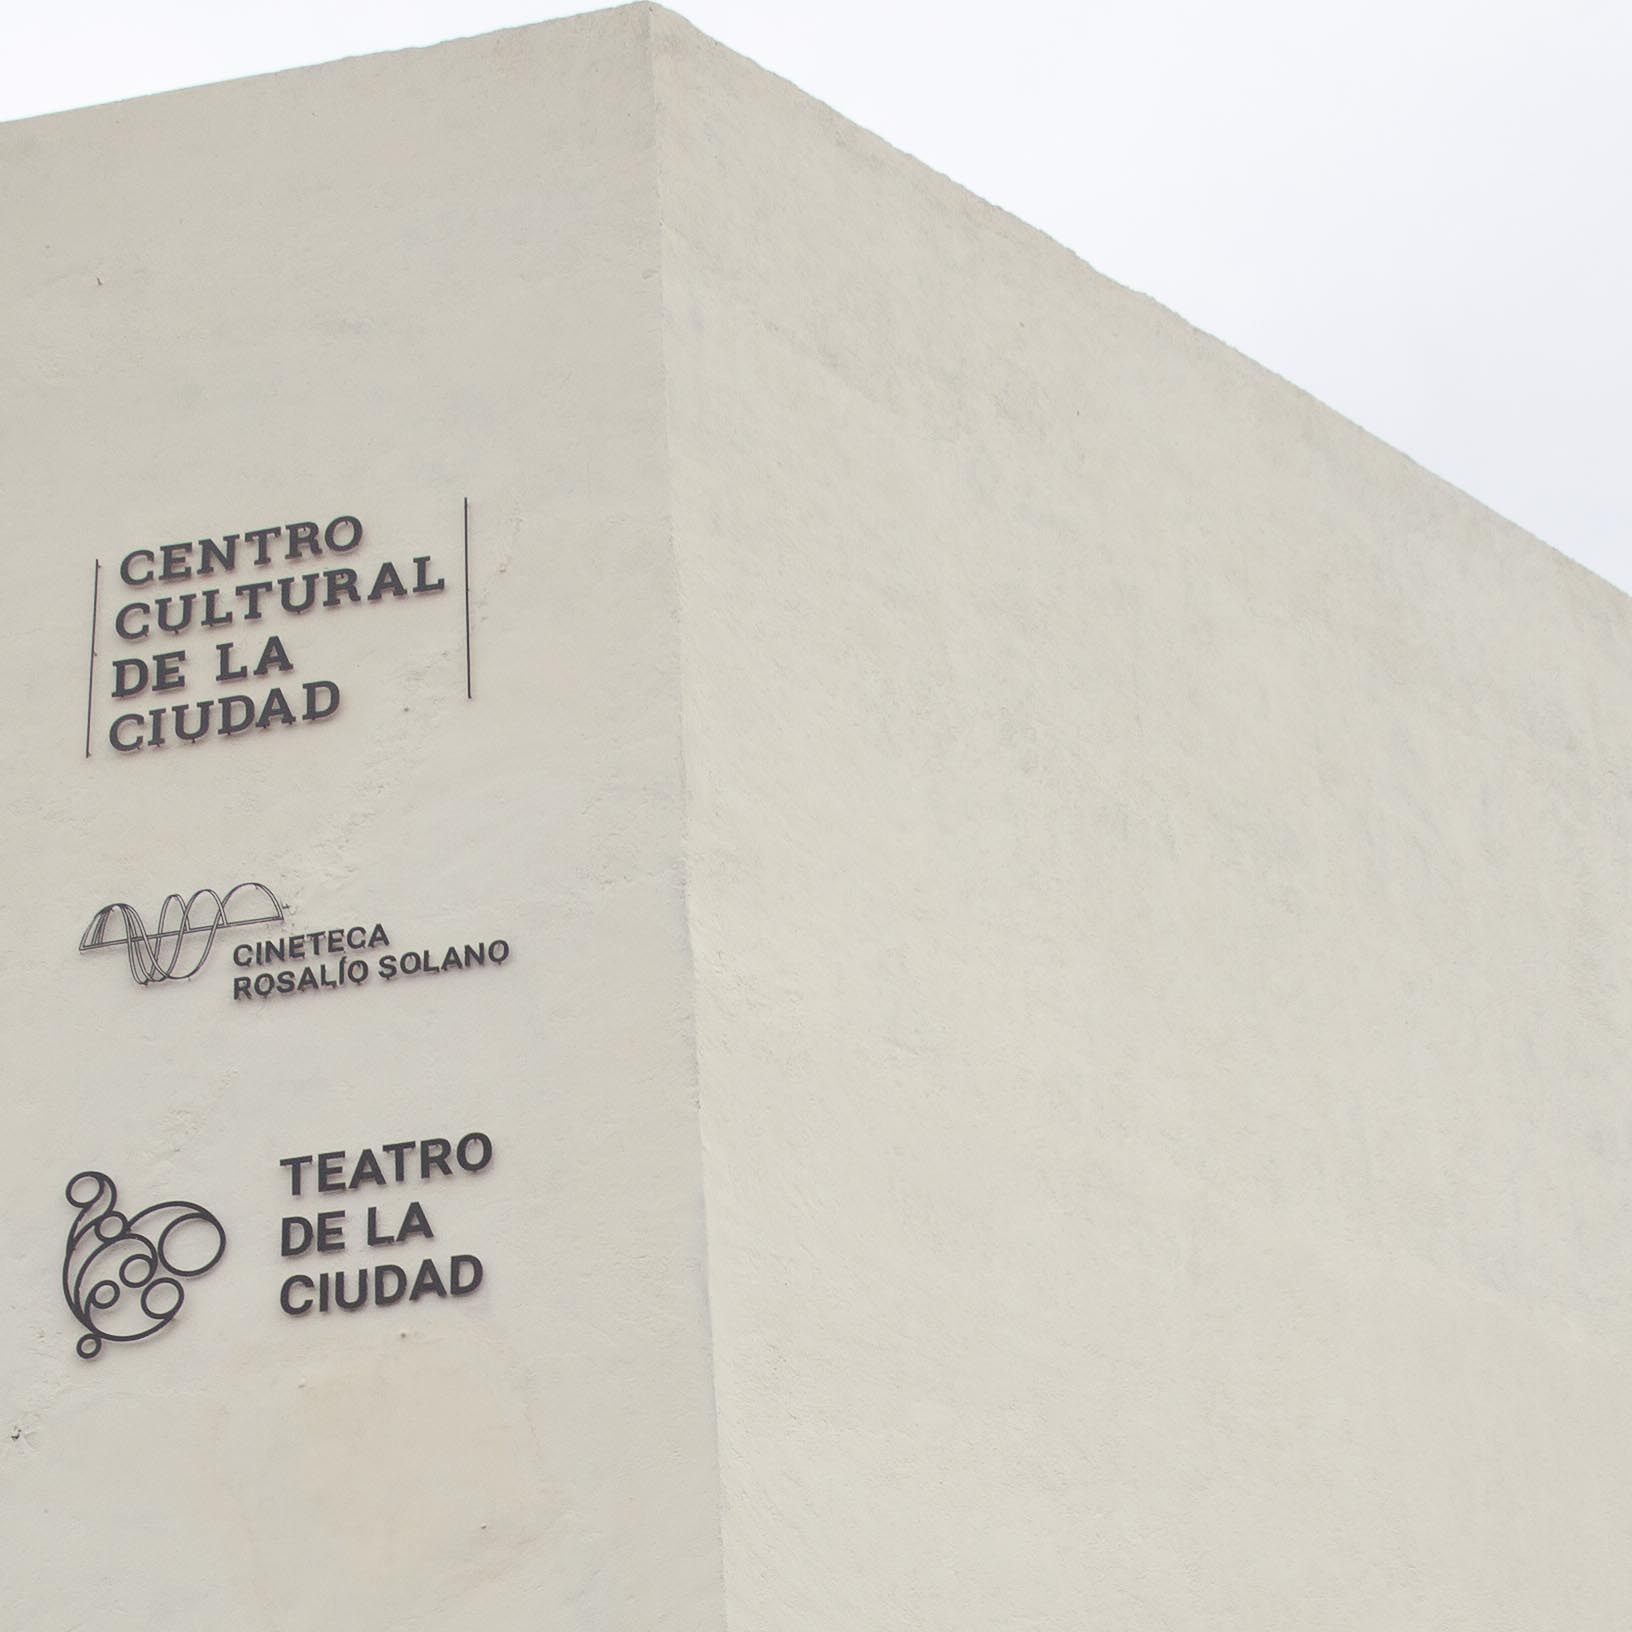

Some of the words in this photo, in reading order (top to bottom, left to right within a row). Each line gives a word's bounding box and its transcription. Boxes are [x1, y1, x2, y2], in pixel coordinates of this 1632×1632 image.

[120, 515, 364, 587] CENTRO
[114, 555, 445, 641] CULTURAL
[112, 649, 187, 698] DE
[215, 635, 294, 682] LA
[108, 679, 341, 752] CIUDAD
[232, 923, 390, 968] CINETECA
[233, 956, 369, 1001] ROSALÍO
[378, 939, 510, 982] SOLANO
[279, 1131, 494, 1196] TEATRO
[281, 1210, 346, 1257] DE
[366, 1201, 435, 1247] LA
[279, 1253, 485, 1316] CIUDAD
